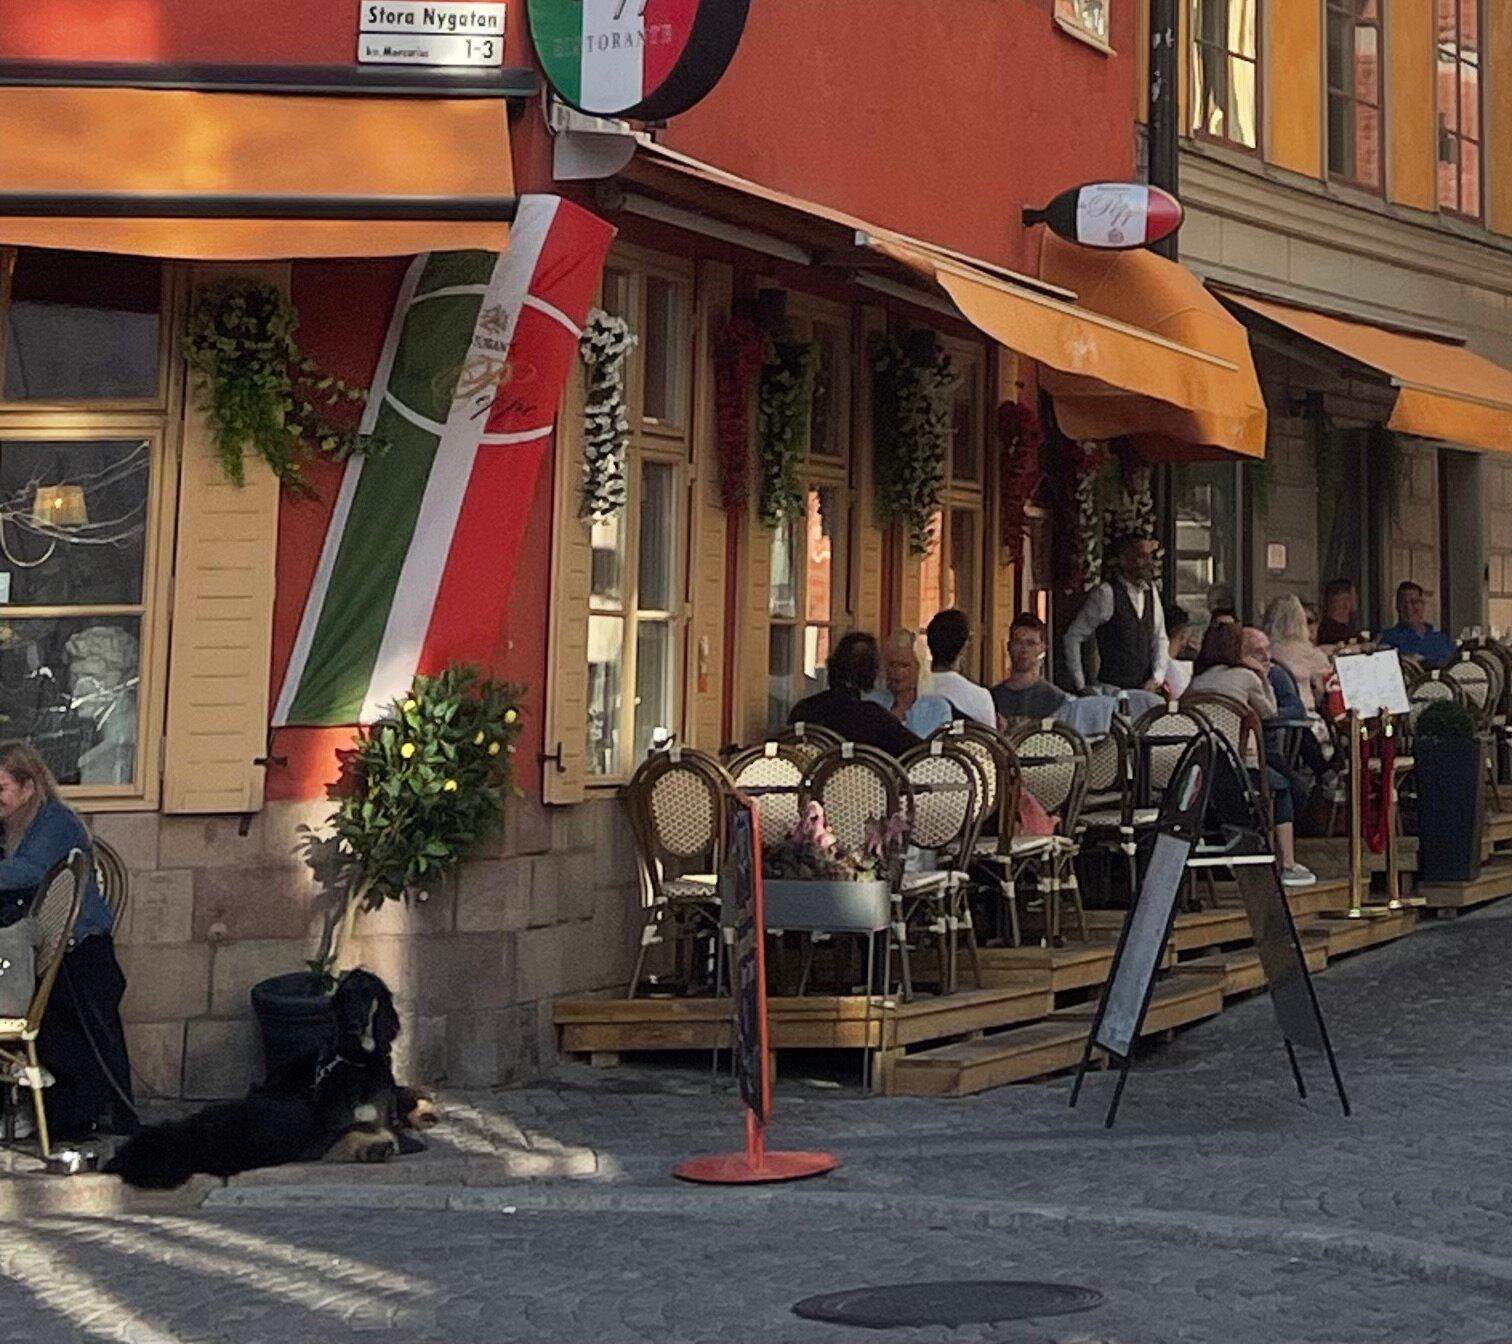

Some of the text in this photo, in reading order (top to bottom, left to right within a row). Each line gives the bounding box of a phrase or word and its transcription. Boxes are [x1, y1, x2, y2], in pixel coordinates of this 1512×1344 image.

[368, 5, 498, 31] Stora Nygatan
[465, 38, 494, 59] 1-3
